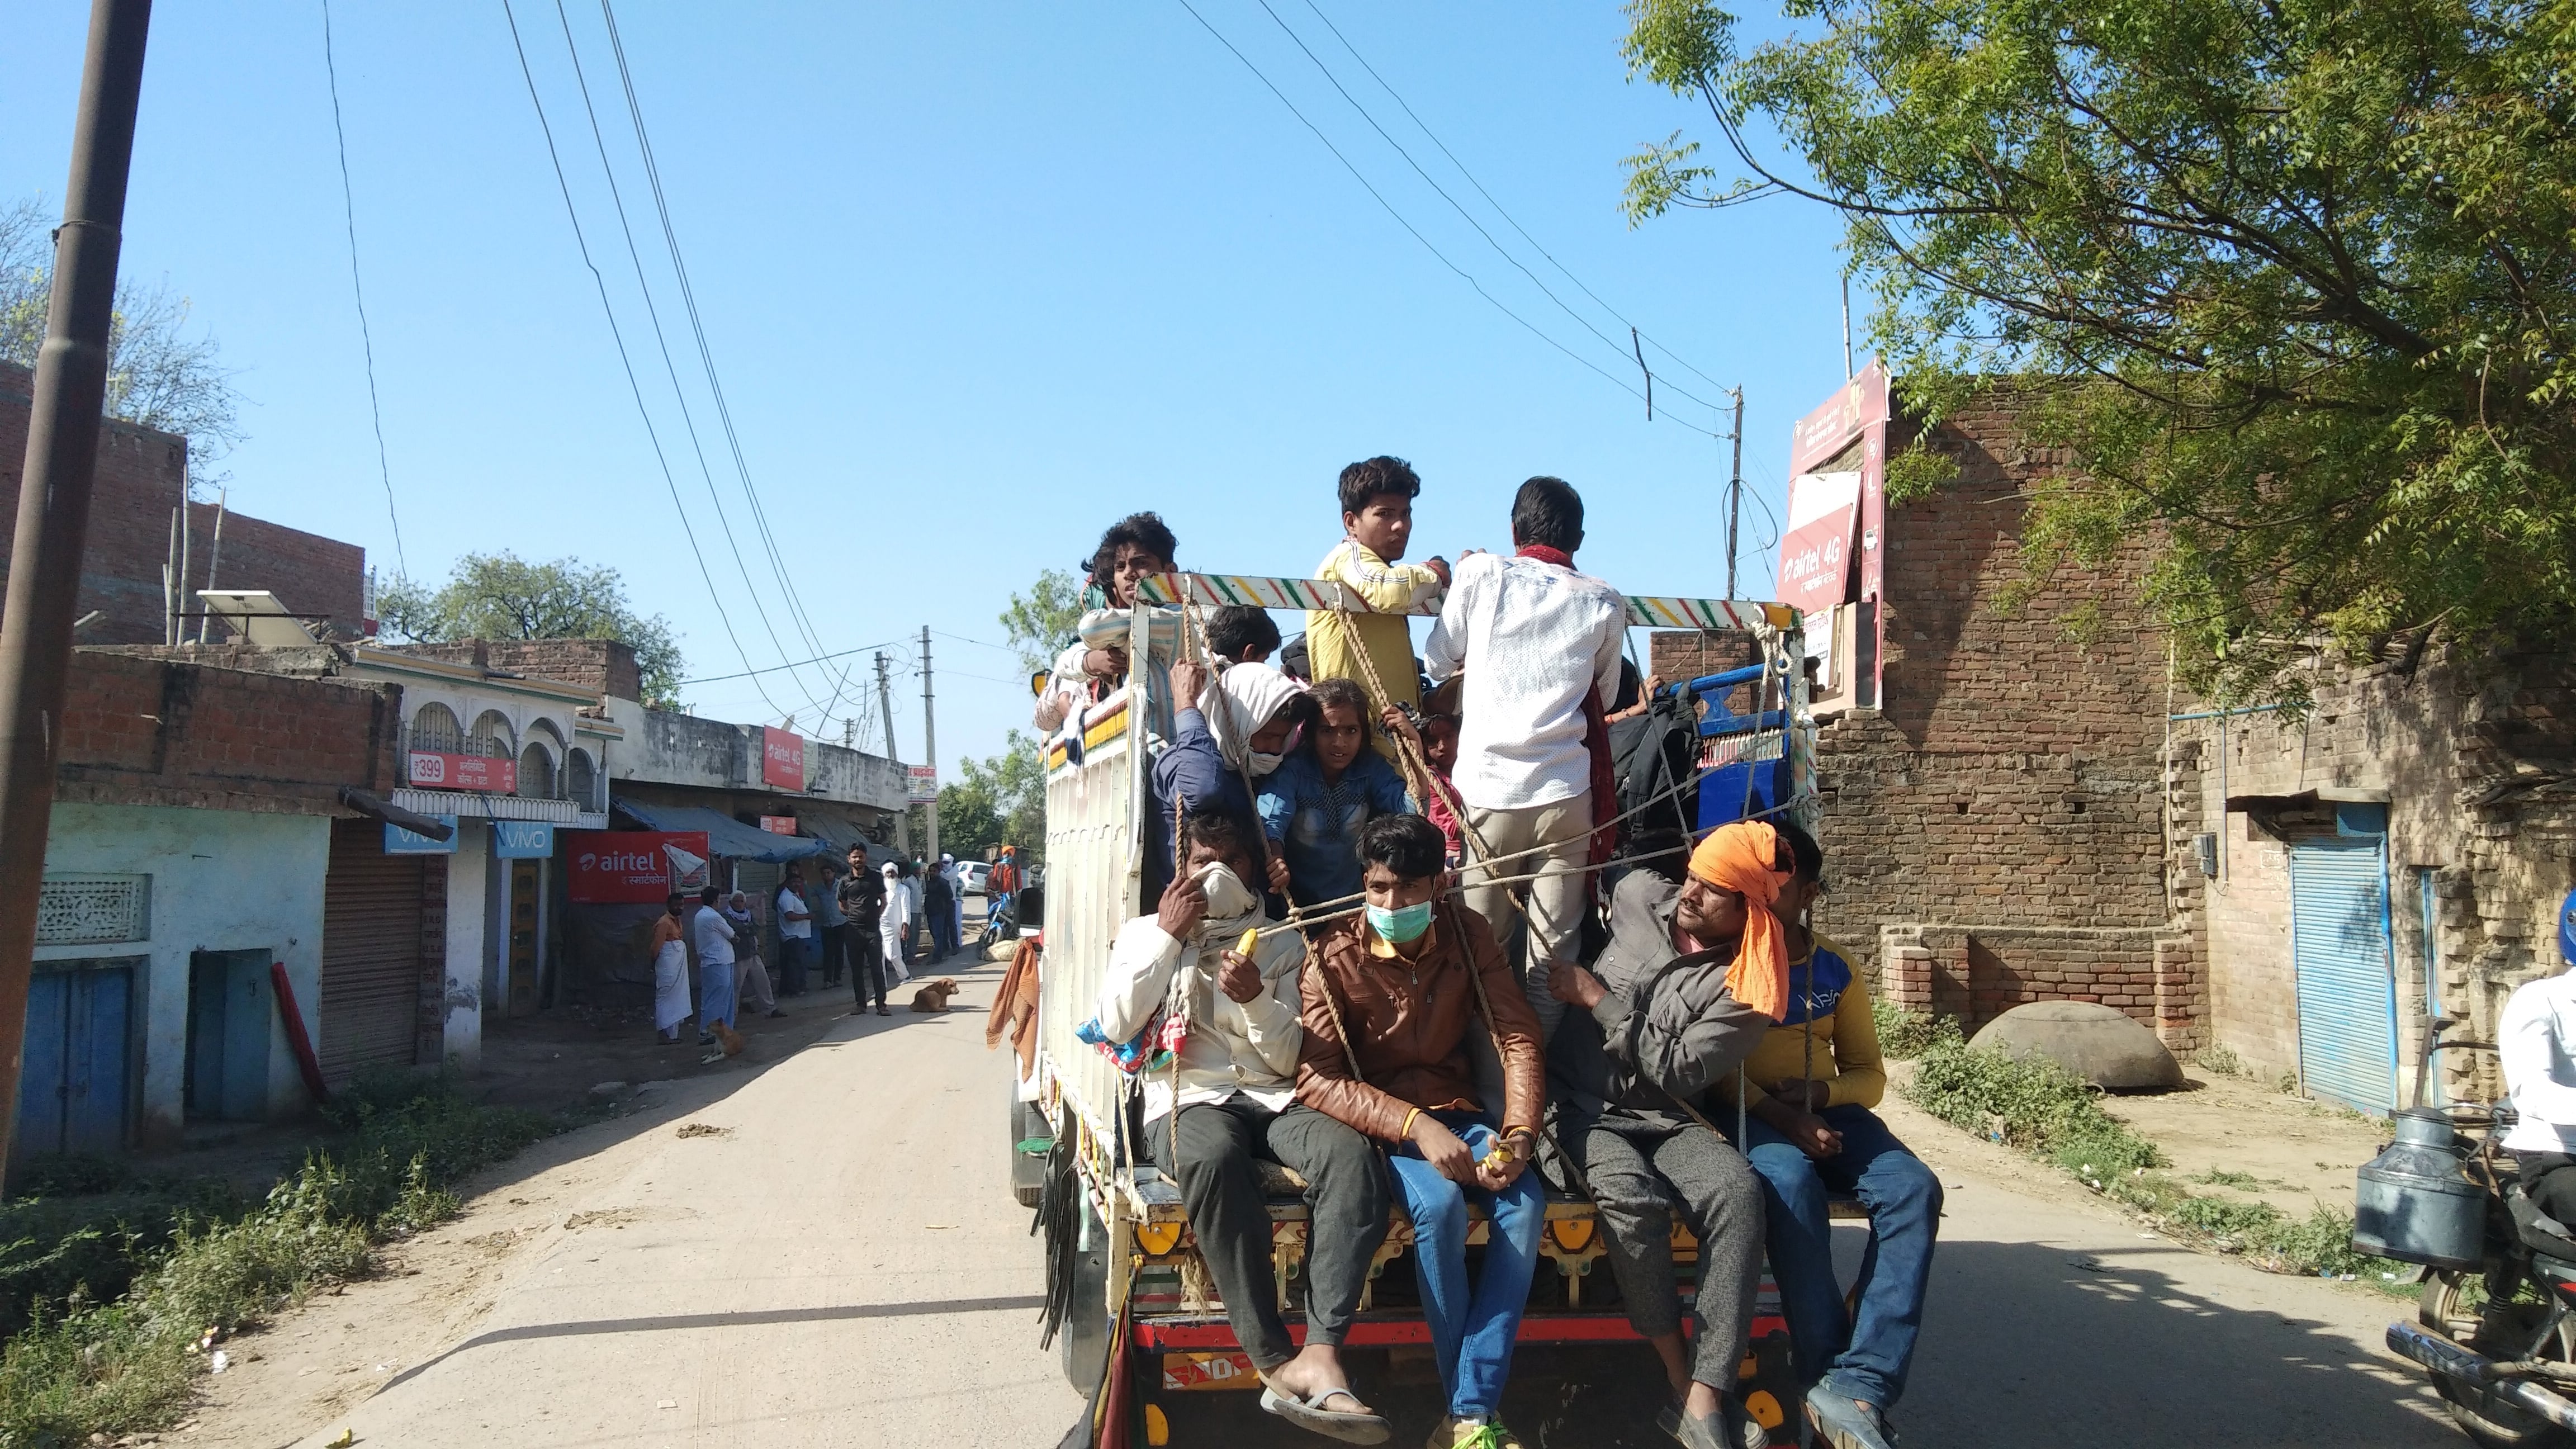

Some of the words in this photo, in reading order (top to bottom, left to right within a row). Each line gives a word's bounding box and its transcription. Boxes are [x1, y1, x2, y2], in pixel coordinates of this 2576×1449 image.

[1793, 544, 1820, 580] airtel
[1824, 536, 1840, 566] 4G
[774, 744, 790, 763] airtel
[792, 750, 800, 765] 4G
[414, 759, 441, 778] ₹399
[601, 850, 656, 872] airtel
